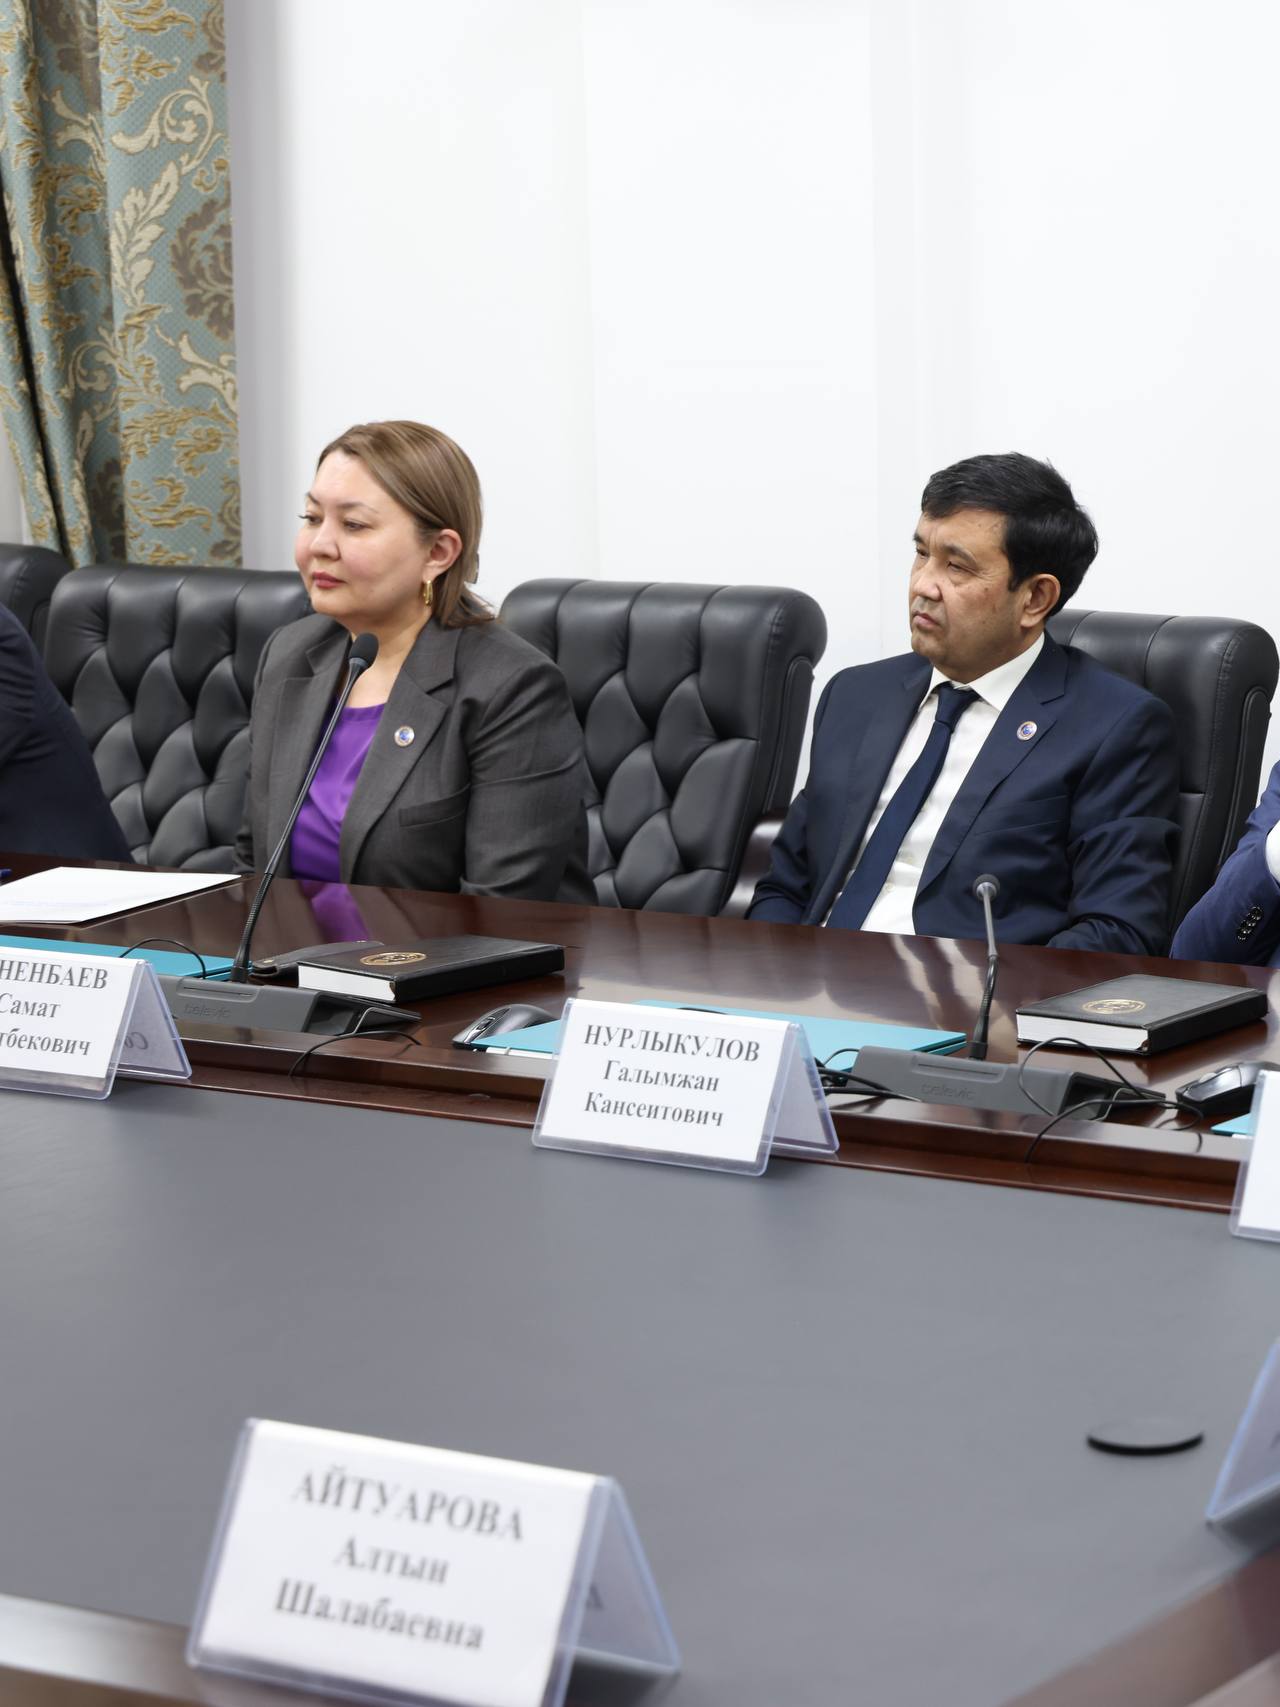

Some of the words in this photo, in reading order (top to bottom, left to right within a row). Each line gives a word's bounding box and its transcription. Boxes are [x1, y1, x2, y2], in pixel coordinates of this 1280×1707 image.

[0, 992, 61, 1018] Самат
[584, 1024, 760, 1062] НУРЛЫКУЛОВ
[602, 1059, 719, 1091] Галымжан
[584, 1091, 724, 1127] Кансеитович
[292, 1465, 524, 1541] АЙТУАРОВА
[335, 1536, 449, 1584] Алтын
[274, 1578, 484, 1649] Шалабаевна
